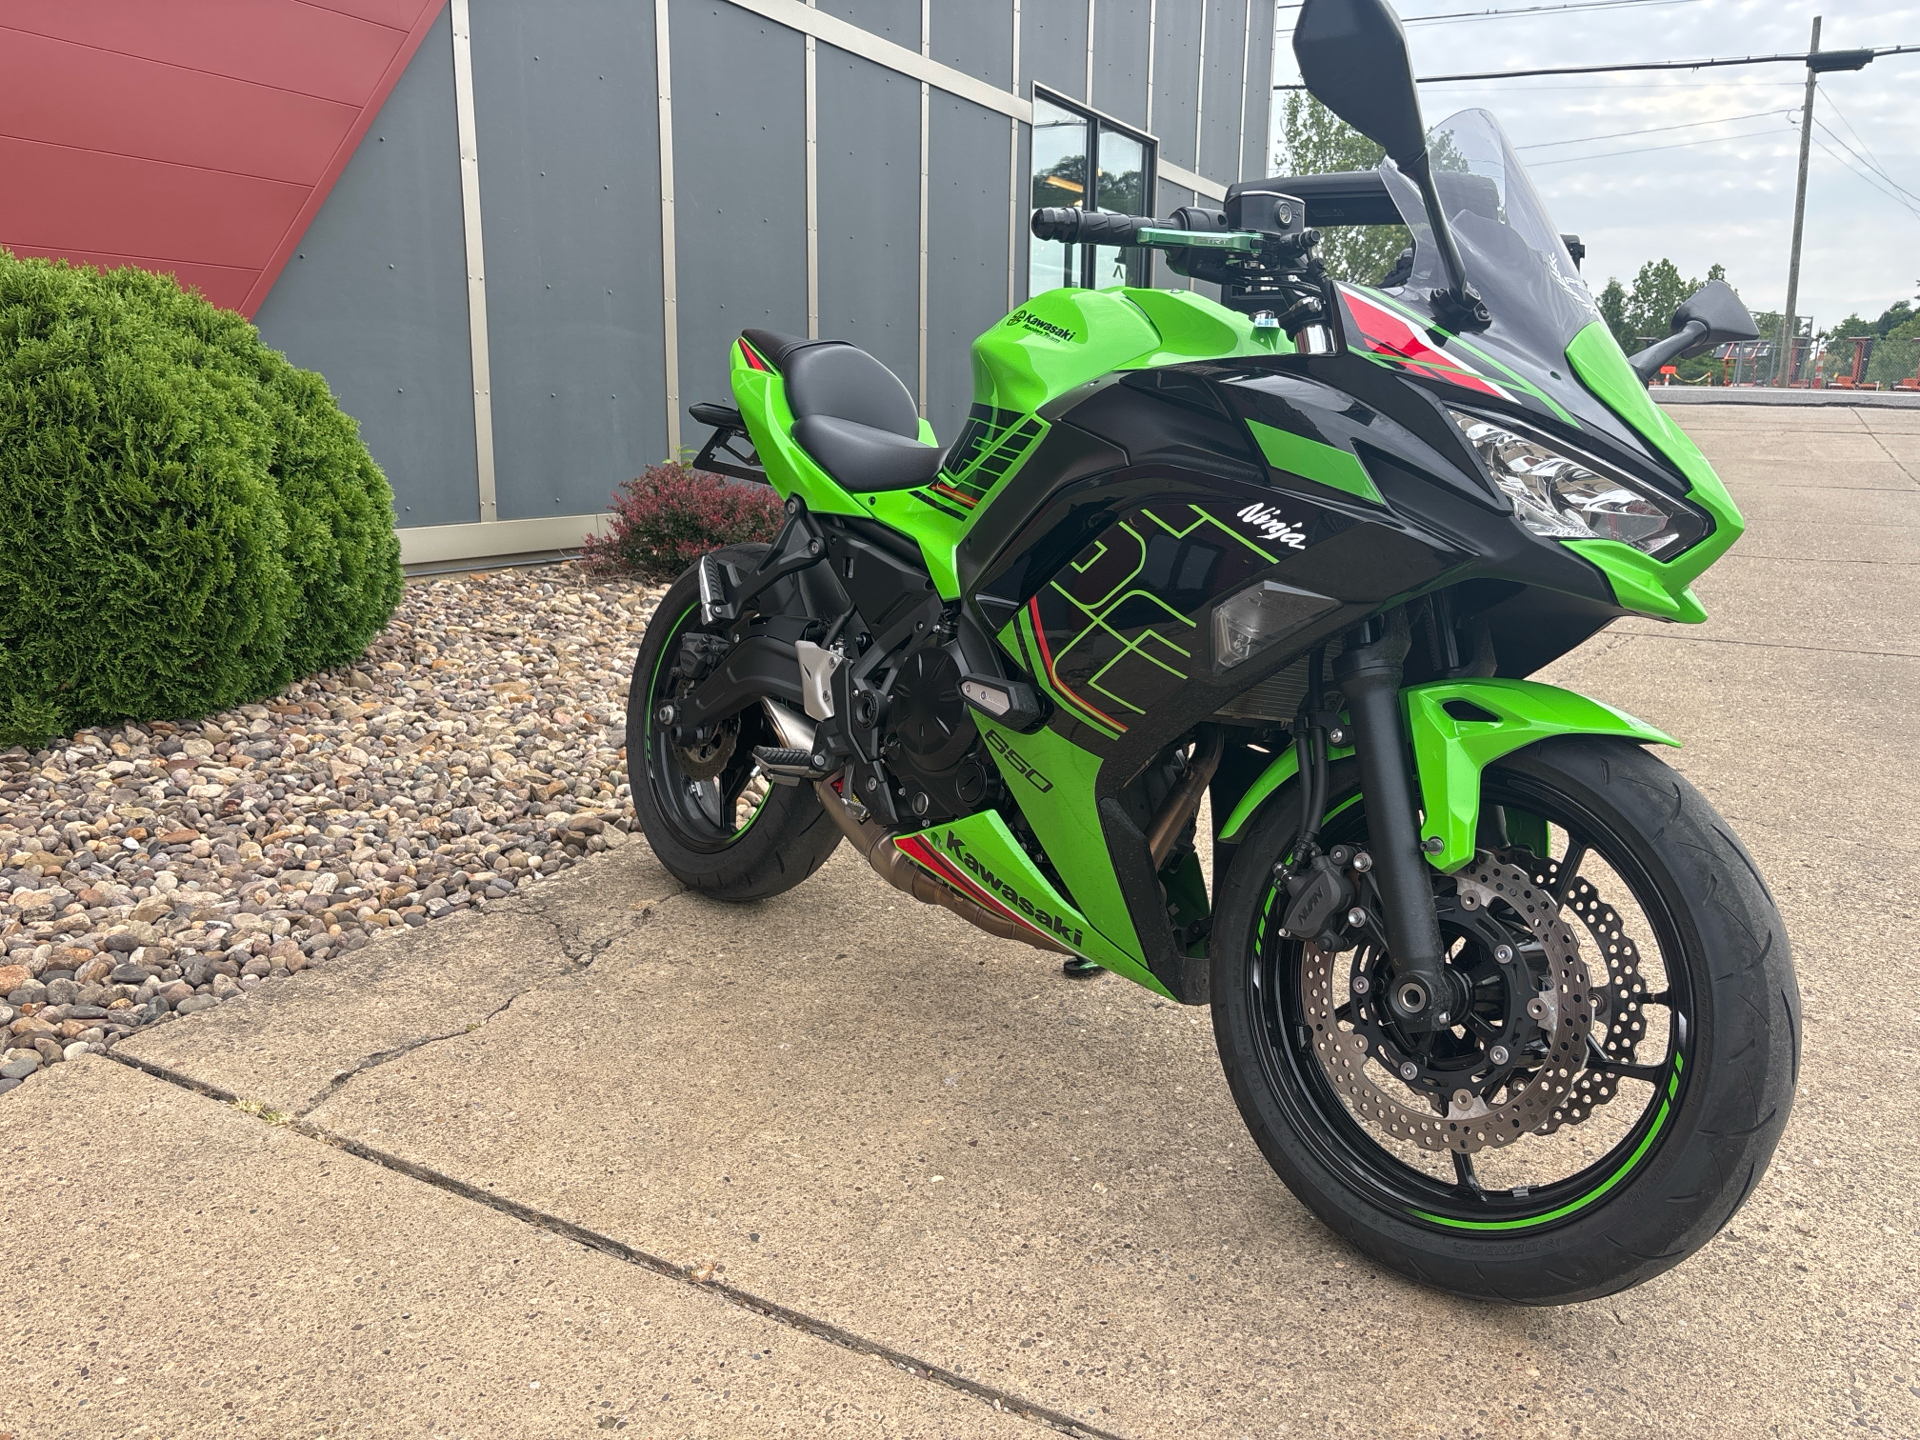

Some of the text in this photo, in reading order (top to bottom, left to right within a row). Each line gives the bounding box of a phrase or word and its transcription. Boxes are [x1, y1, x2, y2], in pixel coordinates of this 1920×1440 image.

[1022, 324, 1060, 343] Racing Team
[1024, 313, 1076, 341] Kawasaki
[1236, 502, 1306, 550] Ninja
[984, 729, 1054, 793] 650
[946, 829, 1083, 947] Kawasaki
